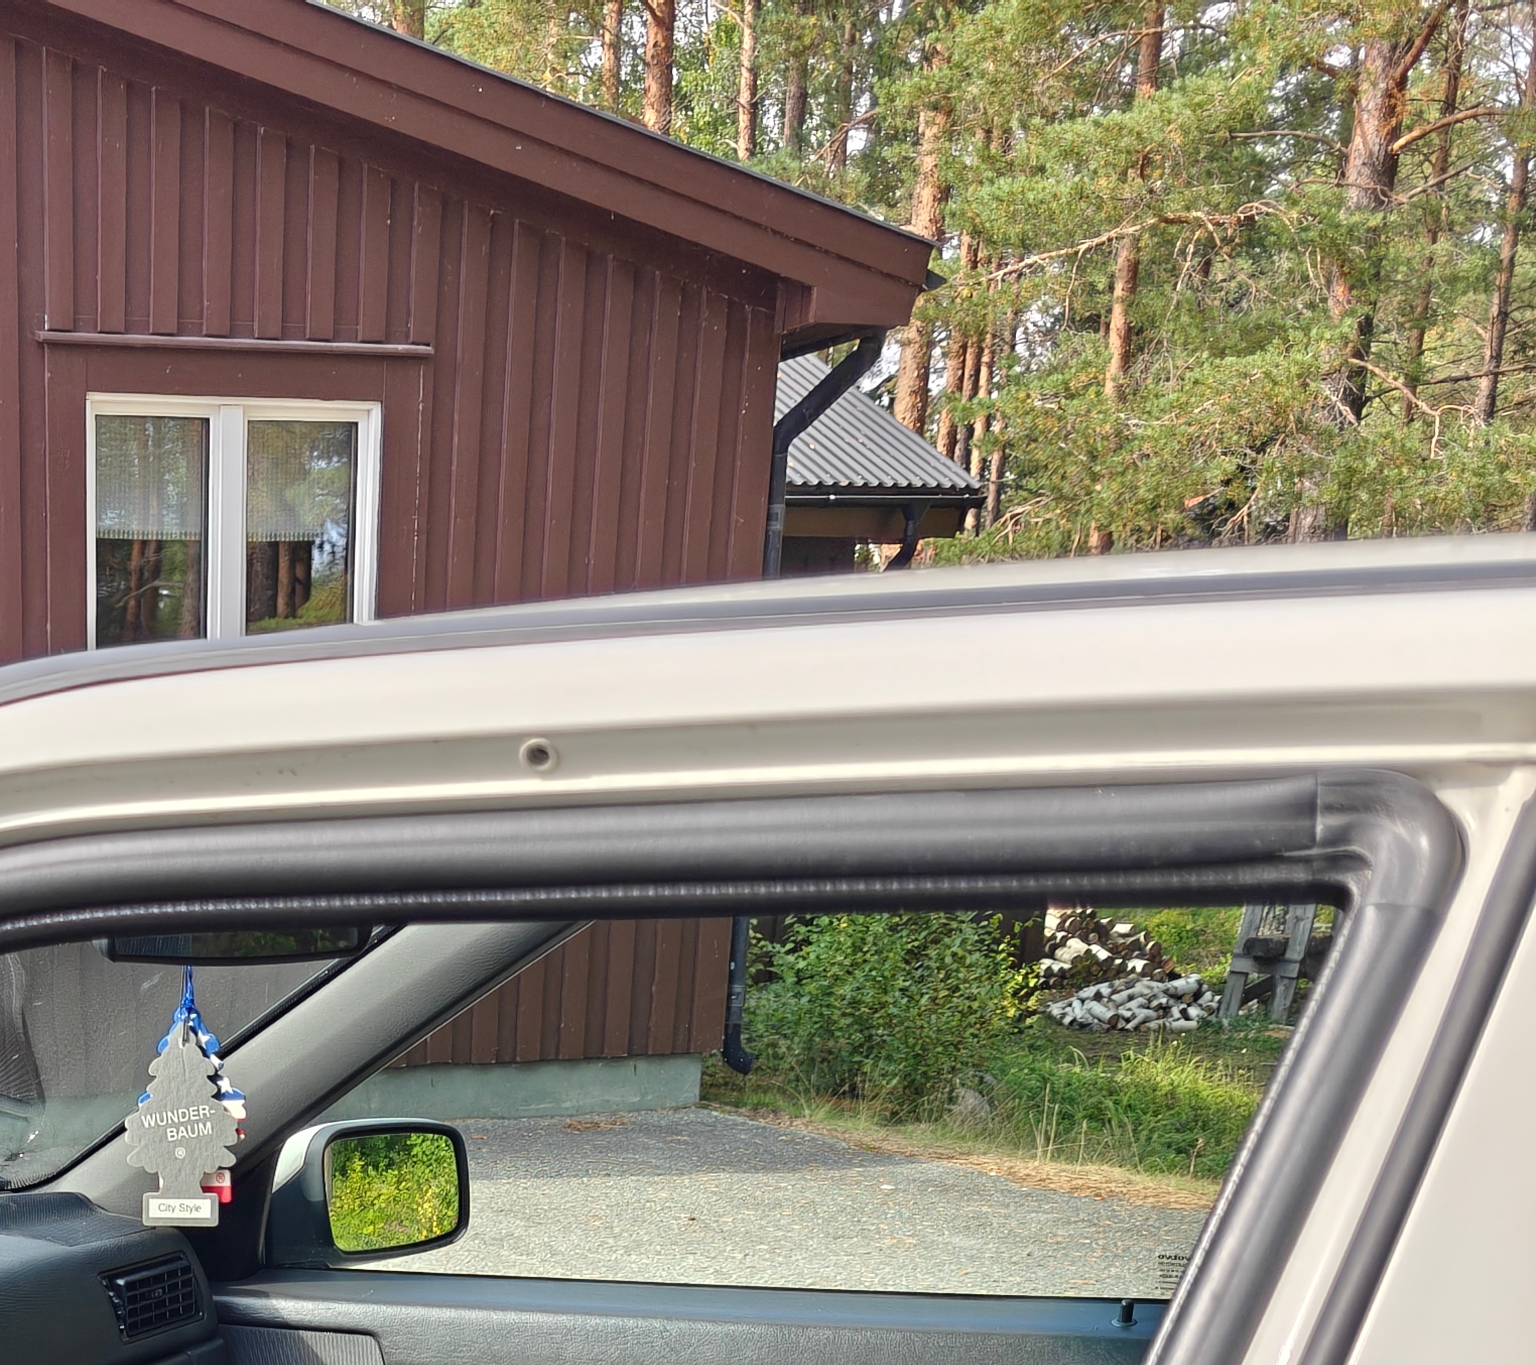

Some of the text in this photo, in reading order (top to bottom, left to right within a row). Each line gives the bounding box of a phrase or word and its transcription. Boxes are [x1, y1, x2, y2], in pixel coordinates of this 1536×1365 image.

[141, 1104, 216, 1128] WUNDER-
[166, 1121, 213, 1141] BAUM
[158, 1202, 202, 1214] City Style
